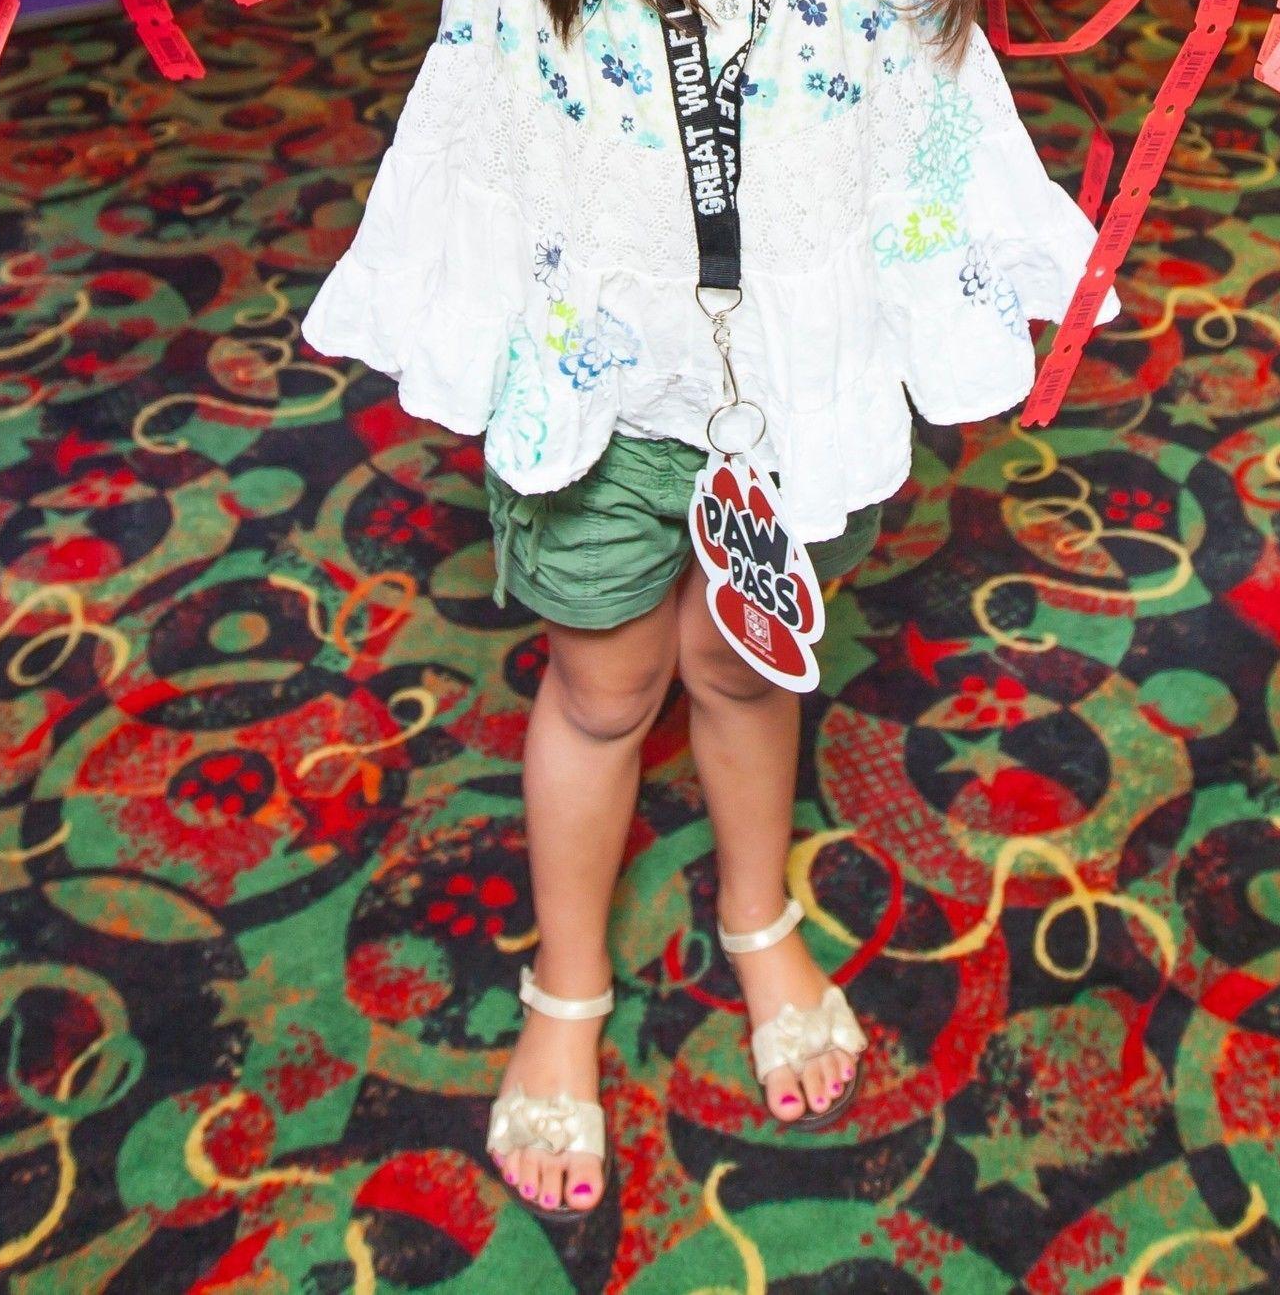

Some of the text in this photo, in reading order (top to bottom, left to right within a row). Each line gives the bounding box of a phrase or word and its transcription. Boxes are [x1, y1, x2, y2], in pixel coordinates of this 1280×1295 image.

[668, 29, 711, 117] WOLF
[685, 125, 727, 217] GREAT
[702, 495, 790, 574] PAW
[729, 556, 803, 629] PASS
